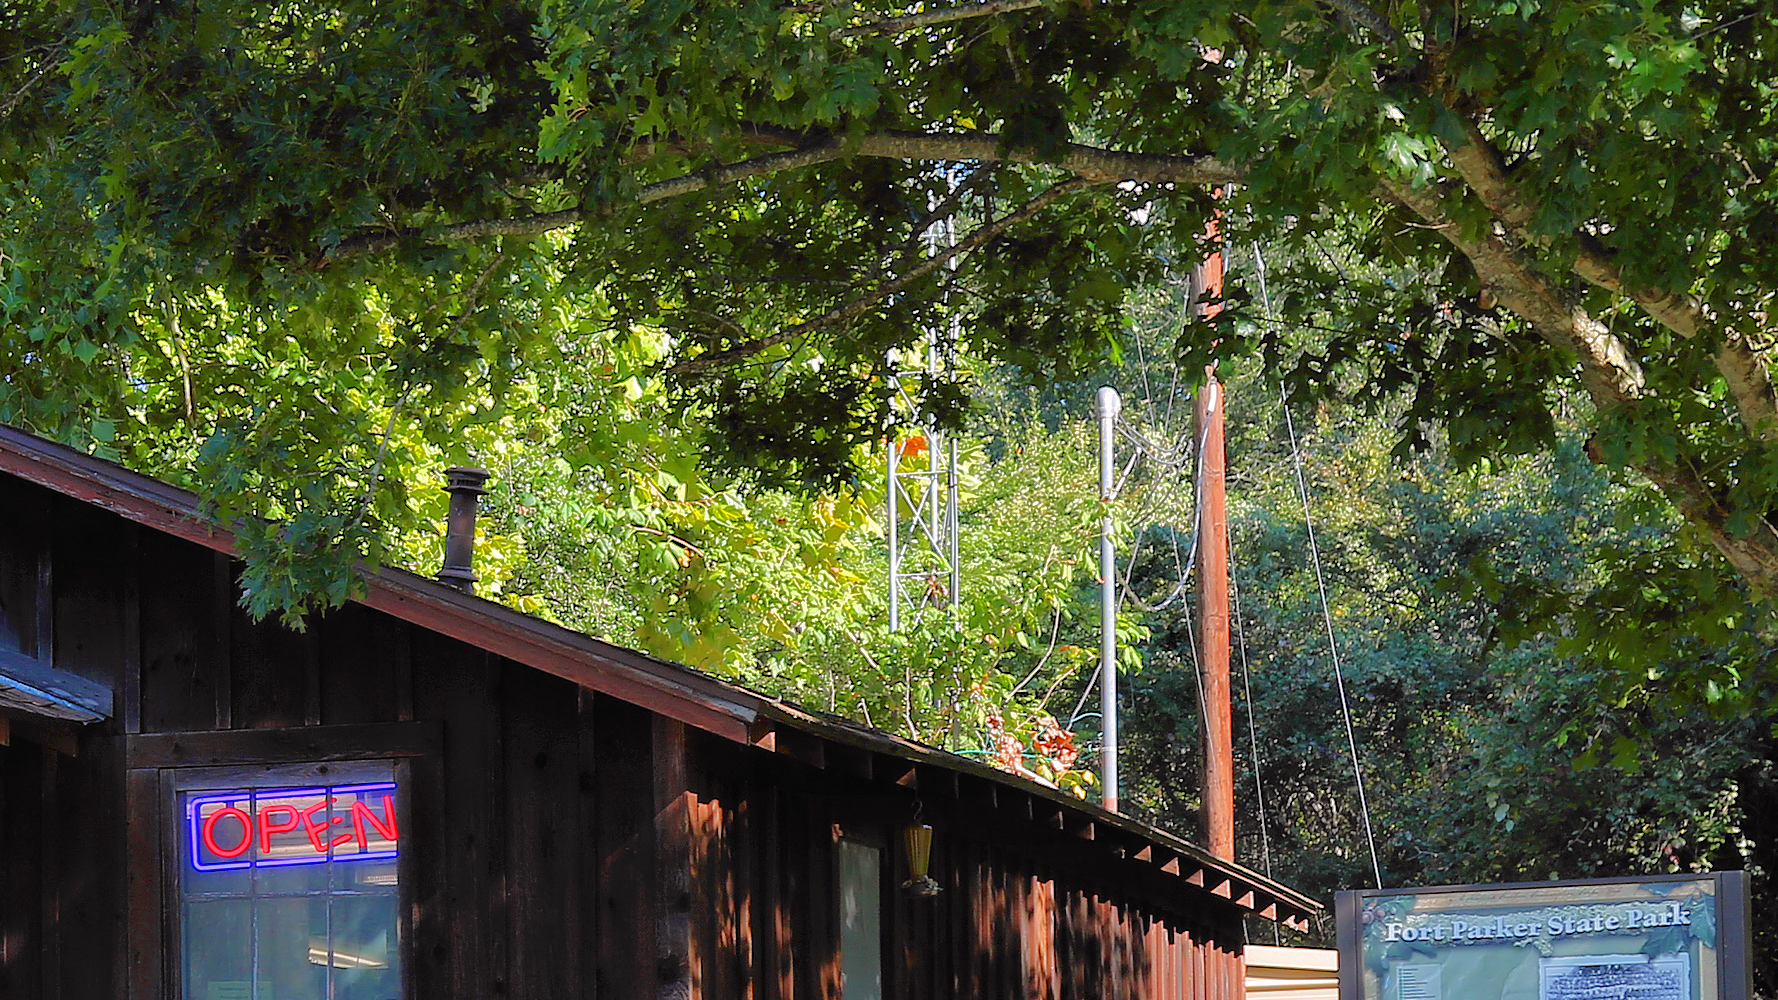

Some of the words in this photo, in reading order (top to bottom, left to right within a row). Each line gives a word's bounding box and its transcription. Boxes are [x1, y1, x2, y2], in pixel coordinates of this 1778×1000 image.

[203, 795, 399, 858] OPEN
[1385, 919, 1444, 942] Fort
[1452, 915, 1542, 940] Parker
[1548, 912, 1619, 935] State
[1626, 905, 1691, 929] Park
